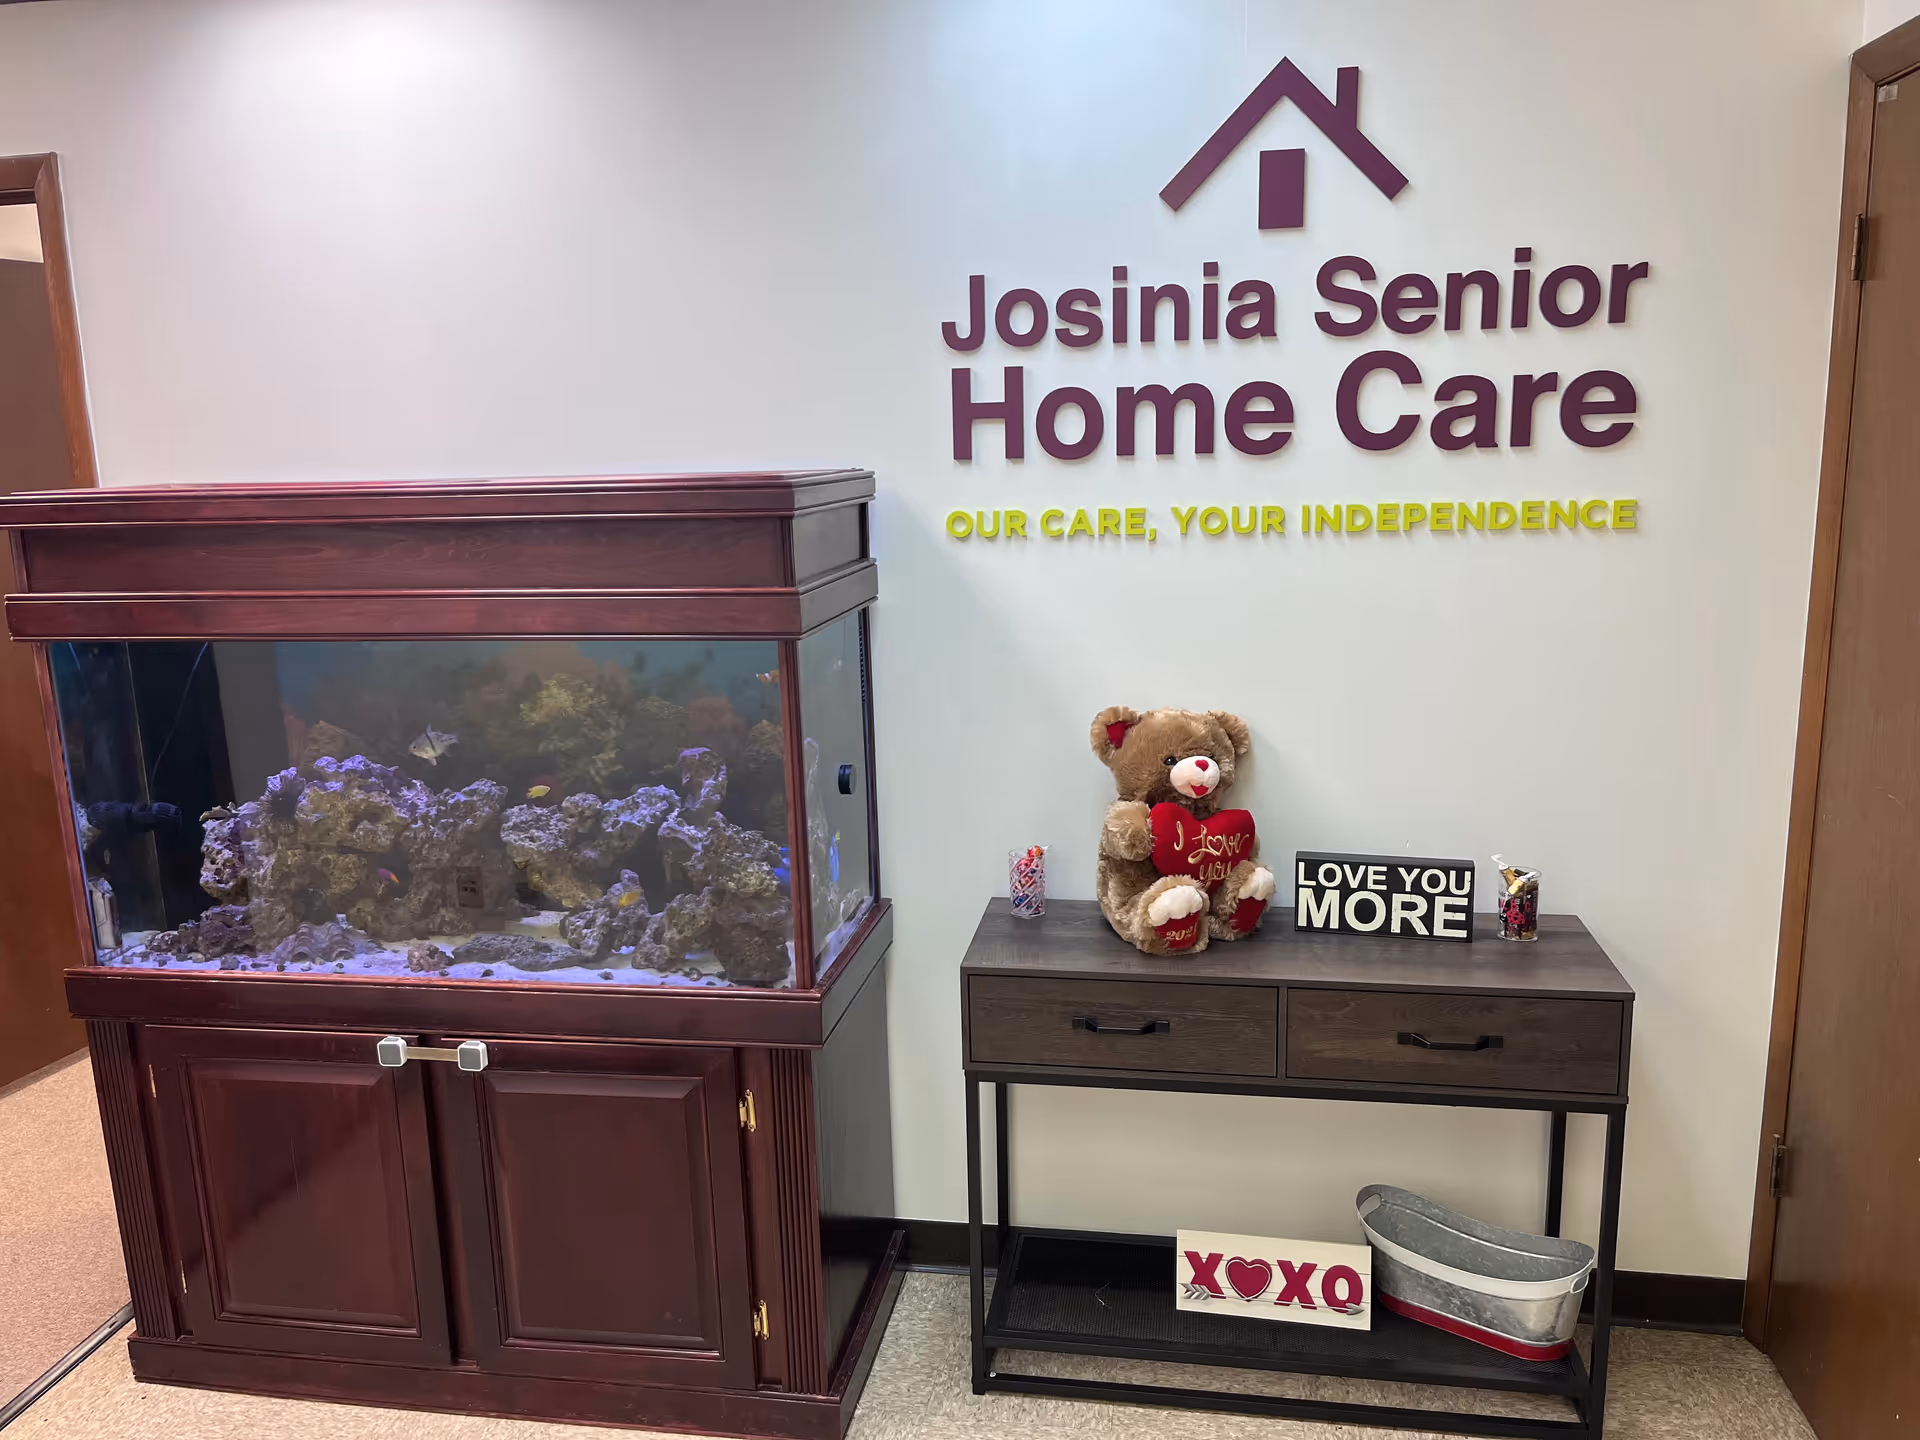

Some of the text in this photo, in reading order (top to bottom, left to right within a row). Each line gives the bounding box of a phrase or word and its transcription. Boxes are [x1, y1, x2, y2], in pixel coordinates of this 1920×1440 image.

[941, 247, 1650, 352] Josinia Senior
[951, 350, 1637, 462] Home Care
[946, 499, 1638, 541] OUR CARE, YOUR INDEPENDENCE
[1174, 820, 1249, 864] I Love
[1298, 861, 1472, 896] LOVE YOU
[1297, 887, 1469, 938] MORE
